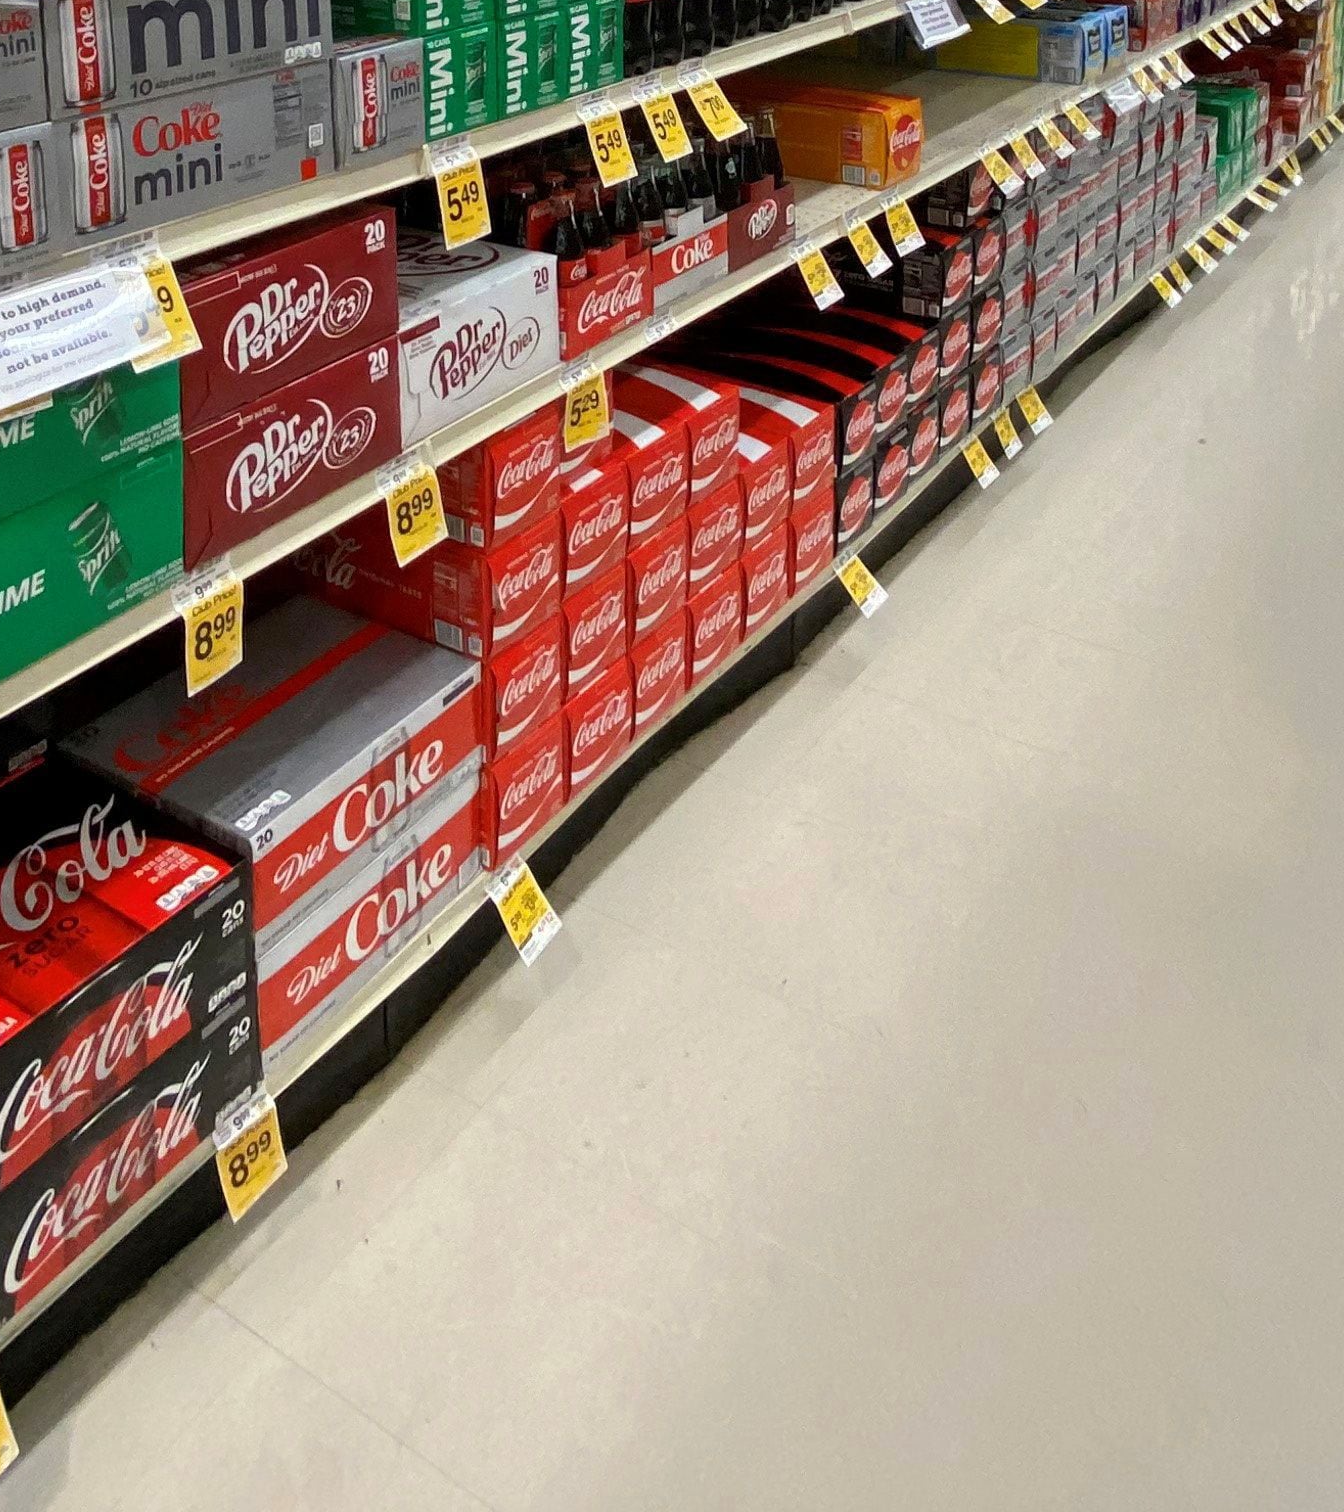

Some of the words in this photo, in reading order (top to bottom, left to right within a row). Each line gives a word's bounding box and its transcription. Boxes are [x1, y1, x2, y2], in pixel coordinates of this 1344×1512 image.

[129, 80, 153, 99] 10
[506, 29, 528, 115] Mini
[429, 48, 453, 136] Mini
[134, 143, 224, 206] mini
[364, 219, 386, 244] 20
[262, 276, 298, 313] Dr
[534, 266, 549, 288] 20
[1, 309, 16, 324] to
[17, 297, 50, 316] high
[33, 298, 94, 330] preferred
[238, 281, 321, 375] Pepper
[337, 298, 356, 322] 23
[7, 356, 32, 375] not
[33, 350, 49, 365] be
[51, 328, 113, 359] available.
[457, 319, 483, 354] Dr
[368, 348, 389, 374] 20
[438, 322, 502, 400] Pepper
[262, 410, 301, 453] Dr
[238, 420, 324, 513] Pepper
[273, 834, 330, 894] Diet
[332, 739, 444, 853] Coke
[256, 828, 274, 851] 20
[220, 898, 246, 923] 20
[286, 943, 342, 1006] Diet
[345, 843, 452, 962] Coke
[5, 914, 80, 969] zero
[229, 1016, 253, 1044] 20
